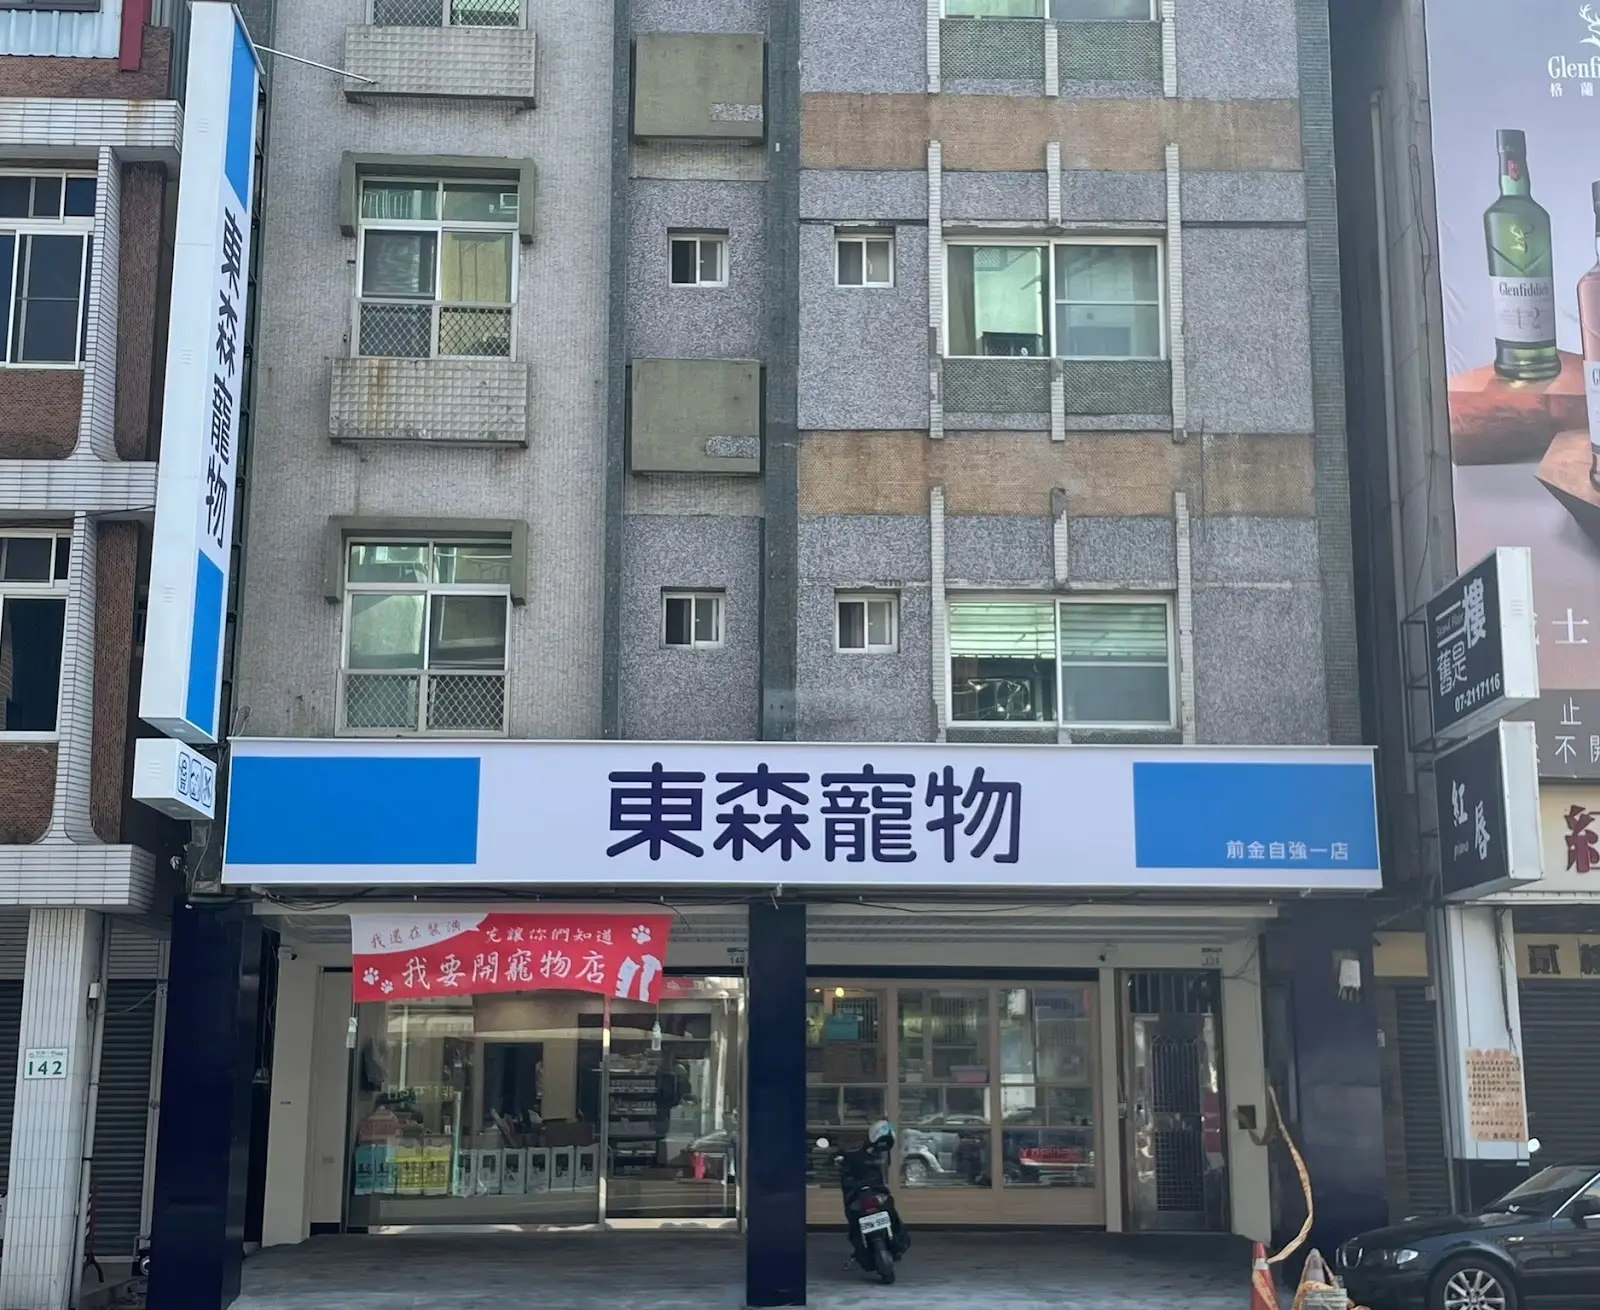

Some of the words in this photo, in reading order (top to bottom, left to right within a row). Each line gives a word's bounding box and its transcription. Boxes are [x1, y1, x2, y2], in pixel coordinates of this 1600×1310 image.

[206, 206, 242, 549] 東森寵物
[1533, 608, 1590, 646] 士
[1437, 640, 1468, 697] 舊是
[1454, 672, 1501, 712] 07-2117116
[606, 762, 1022, 864] 東森寵物
[1226, 840, 1349, 860] 前金自強一店
[370, 919, 460, 949] 我還在裝潢
[486, 926, 614, 945] 先讓你們知道
[401, 948, 606, 990] 我要開寵物店
[28, 1060, 63, 1076] 142
